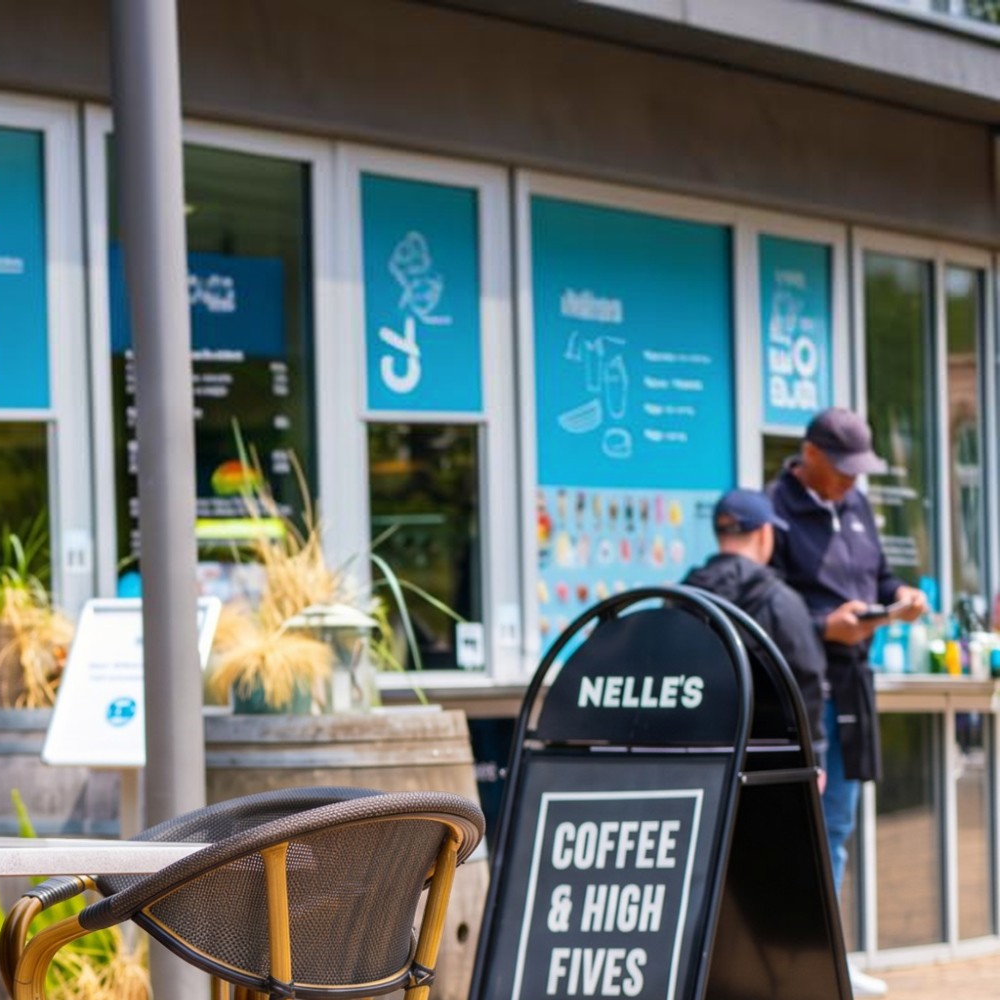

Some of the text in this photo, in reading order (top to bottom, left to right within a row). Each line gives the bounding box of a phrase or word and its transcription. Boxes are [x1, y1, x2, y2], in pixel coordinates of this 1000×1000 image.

[577, 674, 705, 709] NELLE'S
[551, 820, 681, 870] COFFEE
[547, 883, 666, 933] & HIGH
[546, 947, 648, 997] FIVES
